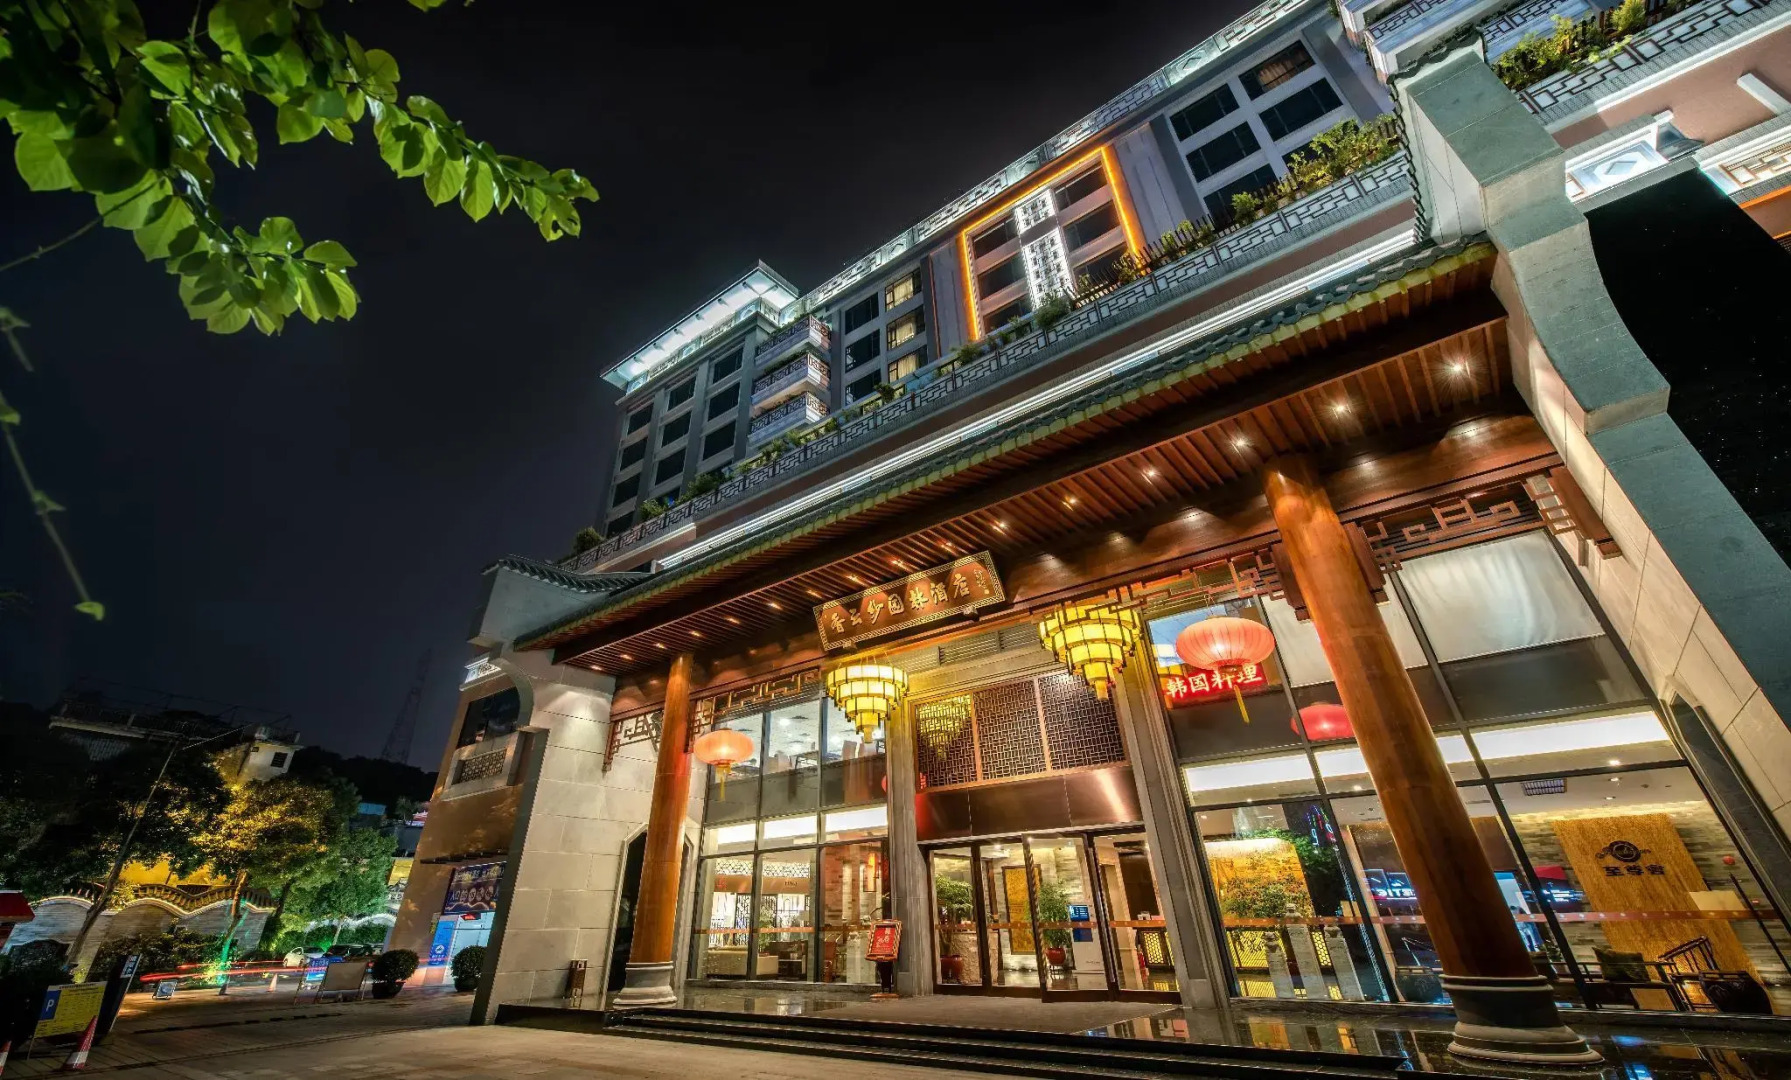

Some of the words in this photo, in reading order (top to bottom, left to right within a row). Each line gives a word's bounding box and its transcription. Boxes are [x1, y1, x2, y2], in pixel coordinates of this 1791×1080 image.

[1166, 663, 1262, 698] 韩国料理
[46, 999, 55, 1012] P
